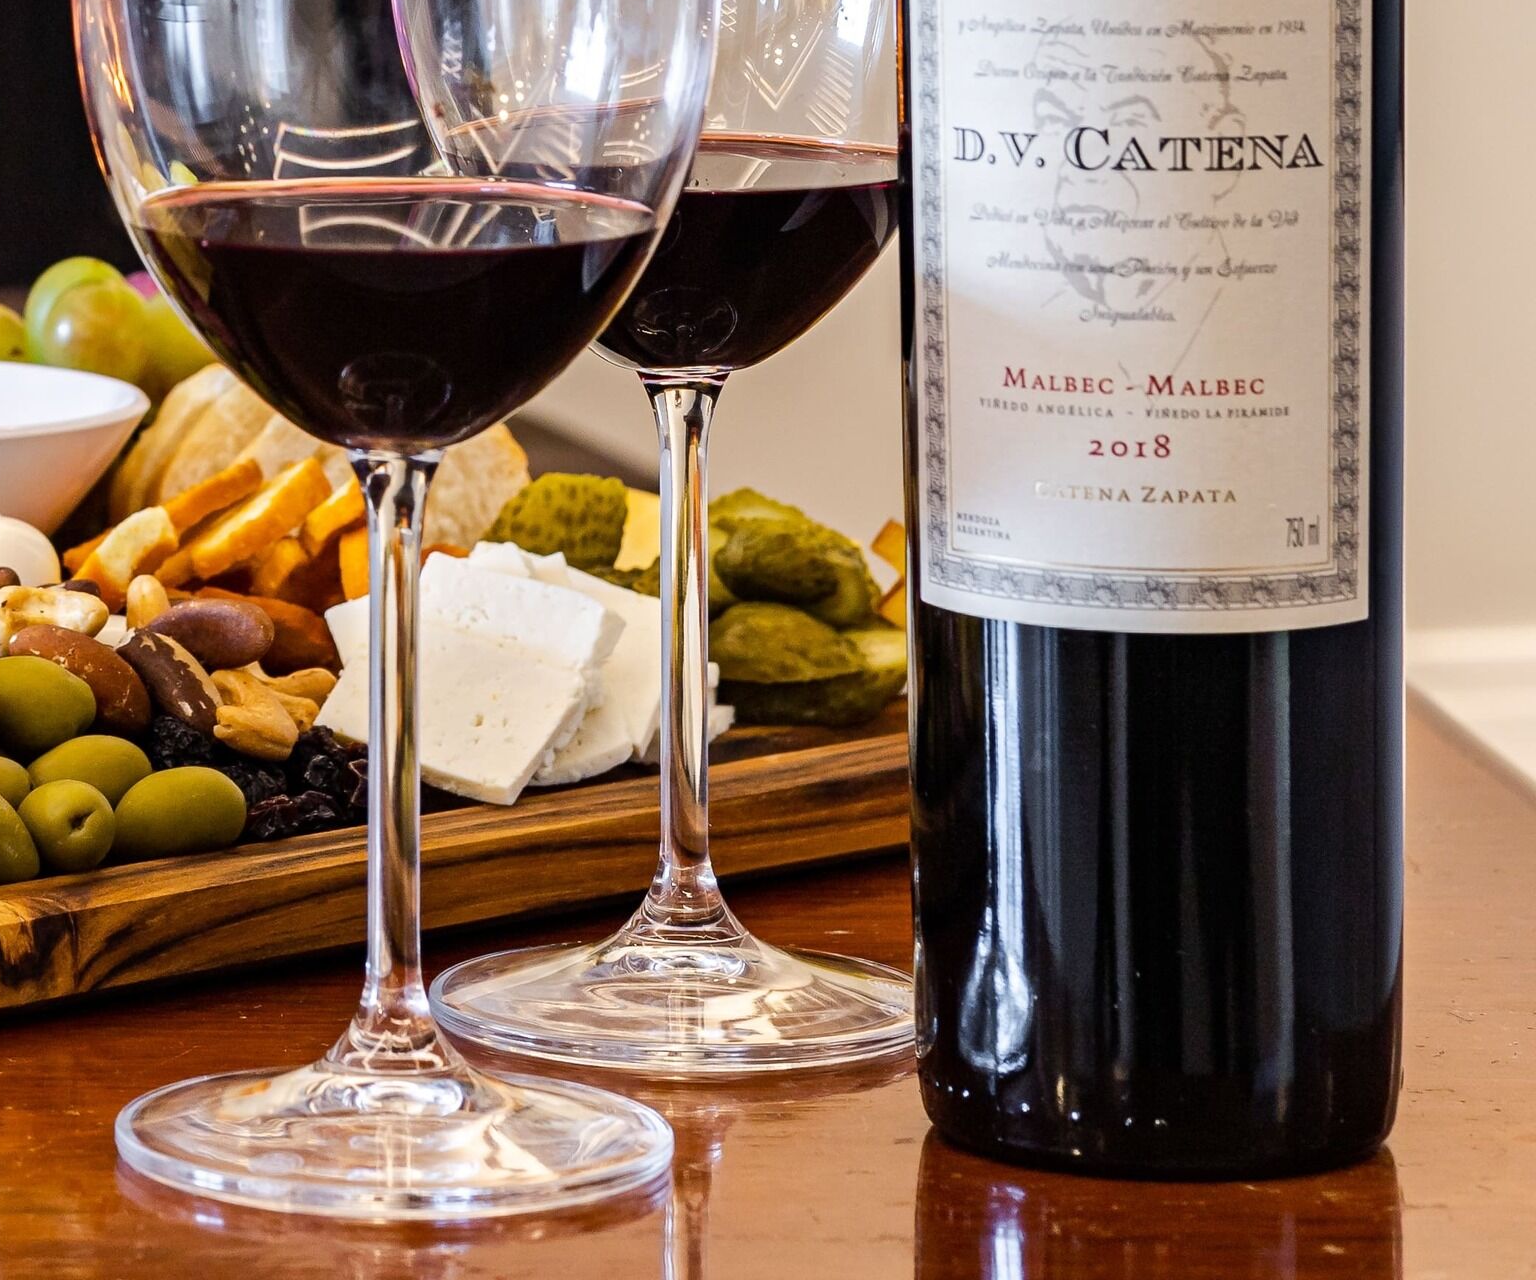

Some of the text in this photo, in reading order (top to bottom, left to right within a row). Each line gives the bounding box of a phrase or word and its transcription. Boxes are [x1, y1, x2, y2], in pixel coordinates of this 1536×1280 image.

[953, 126, 1325, 172] D.V. CATENA
[1003, 366, 1115, 396] MALBEC
[1144, 374, 1266, 397] MALBEC
[1145, 407, 1201, 420] VIÑEDO
[1205, 409, 1222, 420] LA
[1088, 434, 1172, 459] 2018
[1141, 486, 1238, 504] ZAPATA
